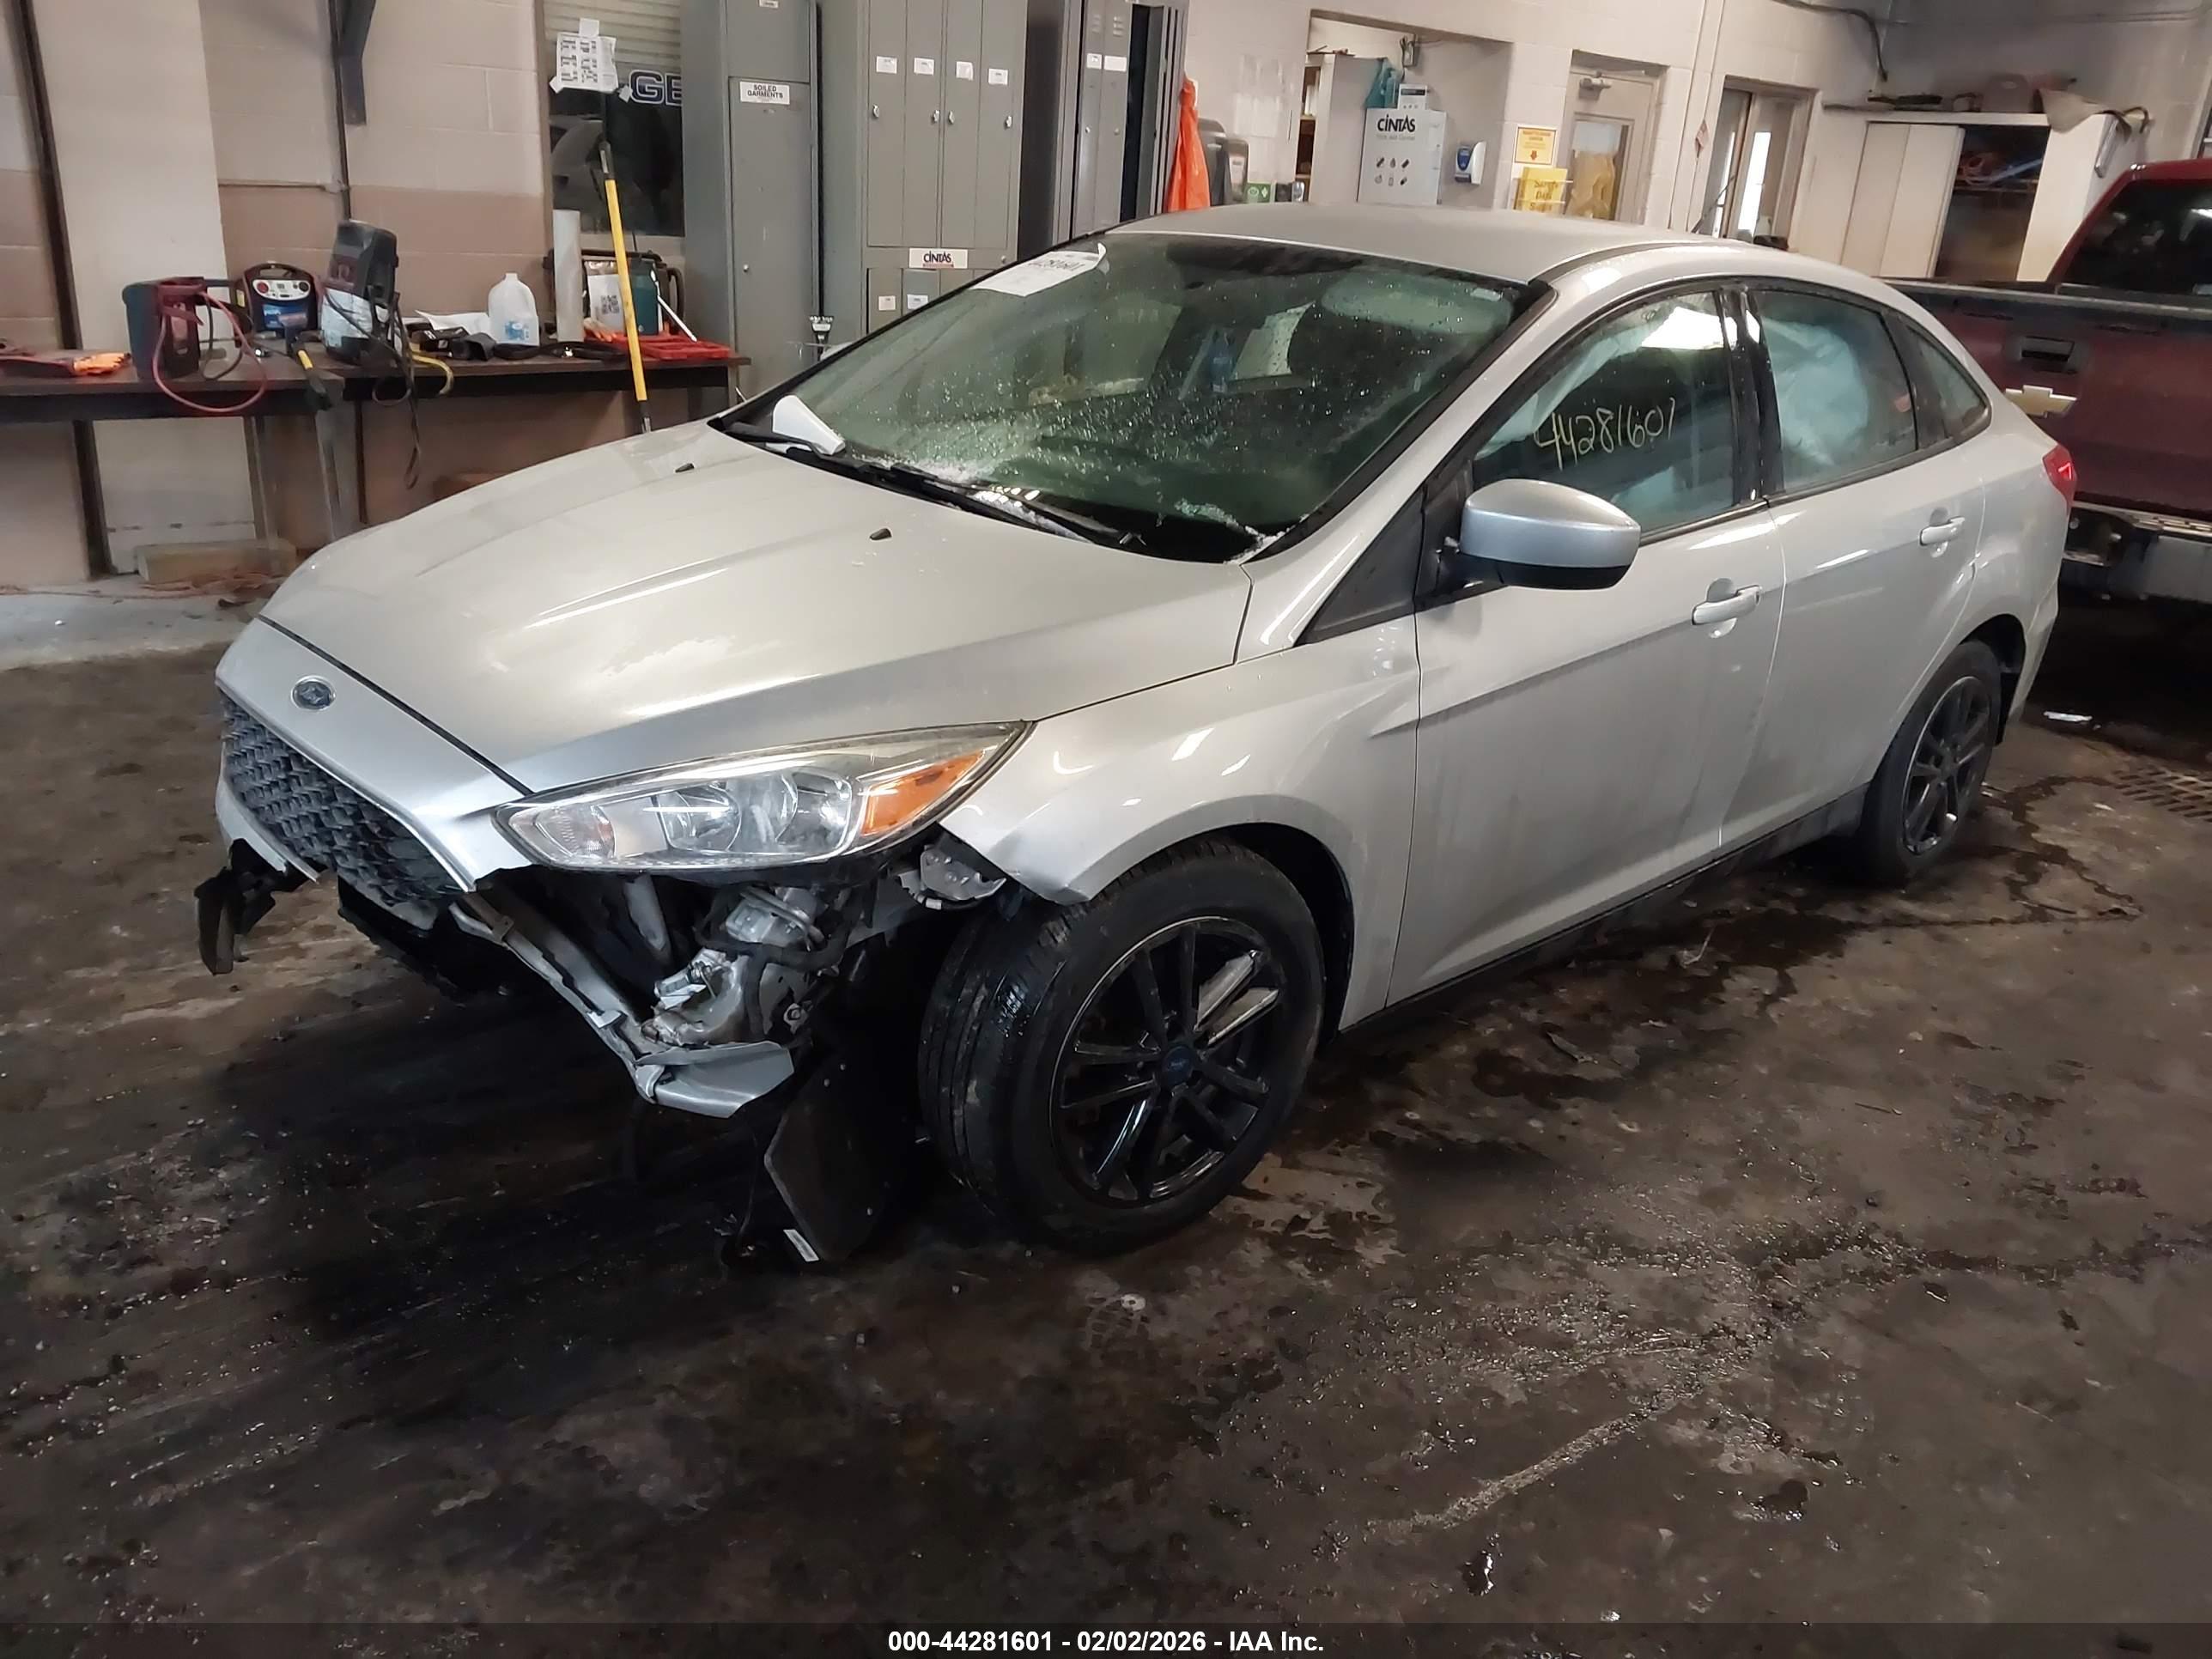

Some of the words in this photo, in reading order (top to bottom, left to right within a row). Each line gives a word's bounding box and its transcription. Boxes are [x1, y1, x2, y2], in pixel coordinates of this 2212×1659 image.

[747, 89, 784, 99] GARMENTS
[1376, 113, 1416, 132] CINTAS
[923, 250, 951, 263] CINTAS
[1533, 397, 1675, 471] 44281601
